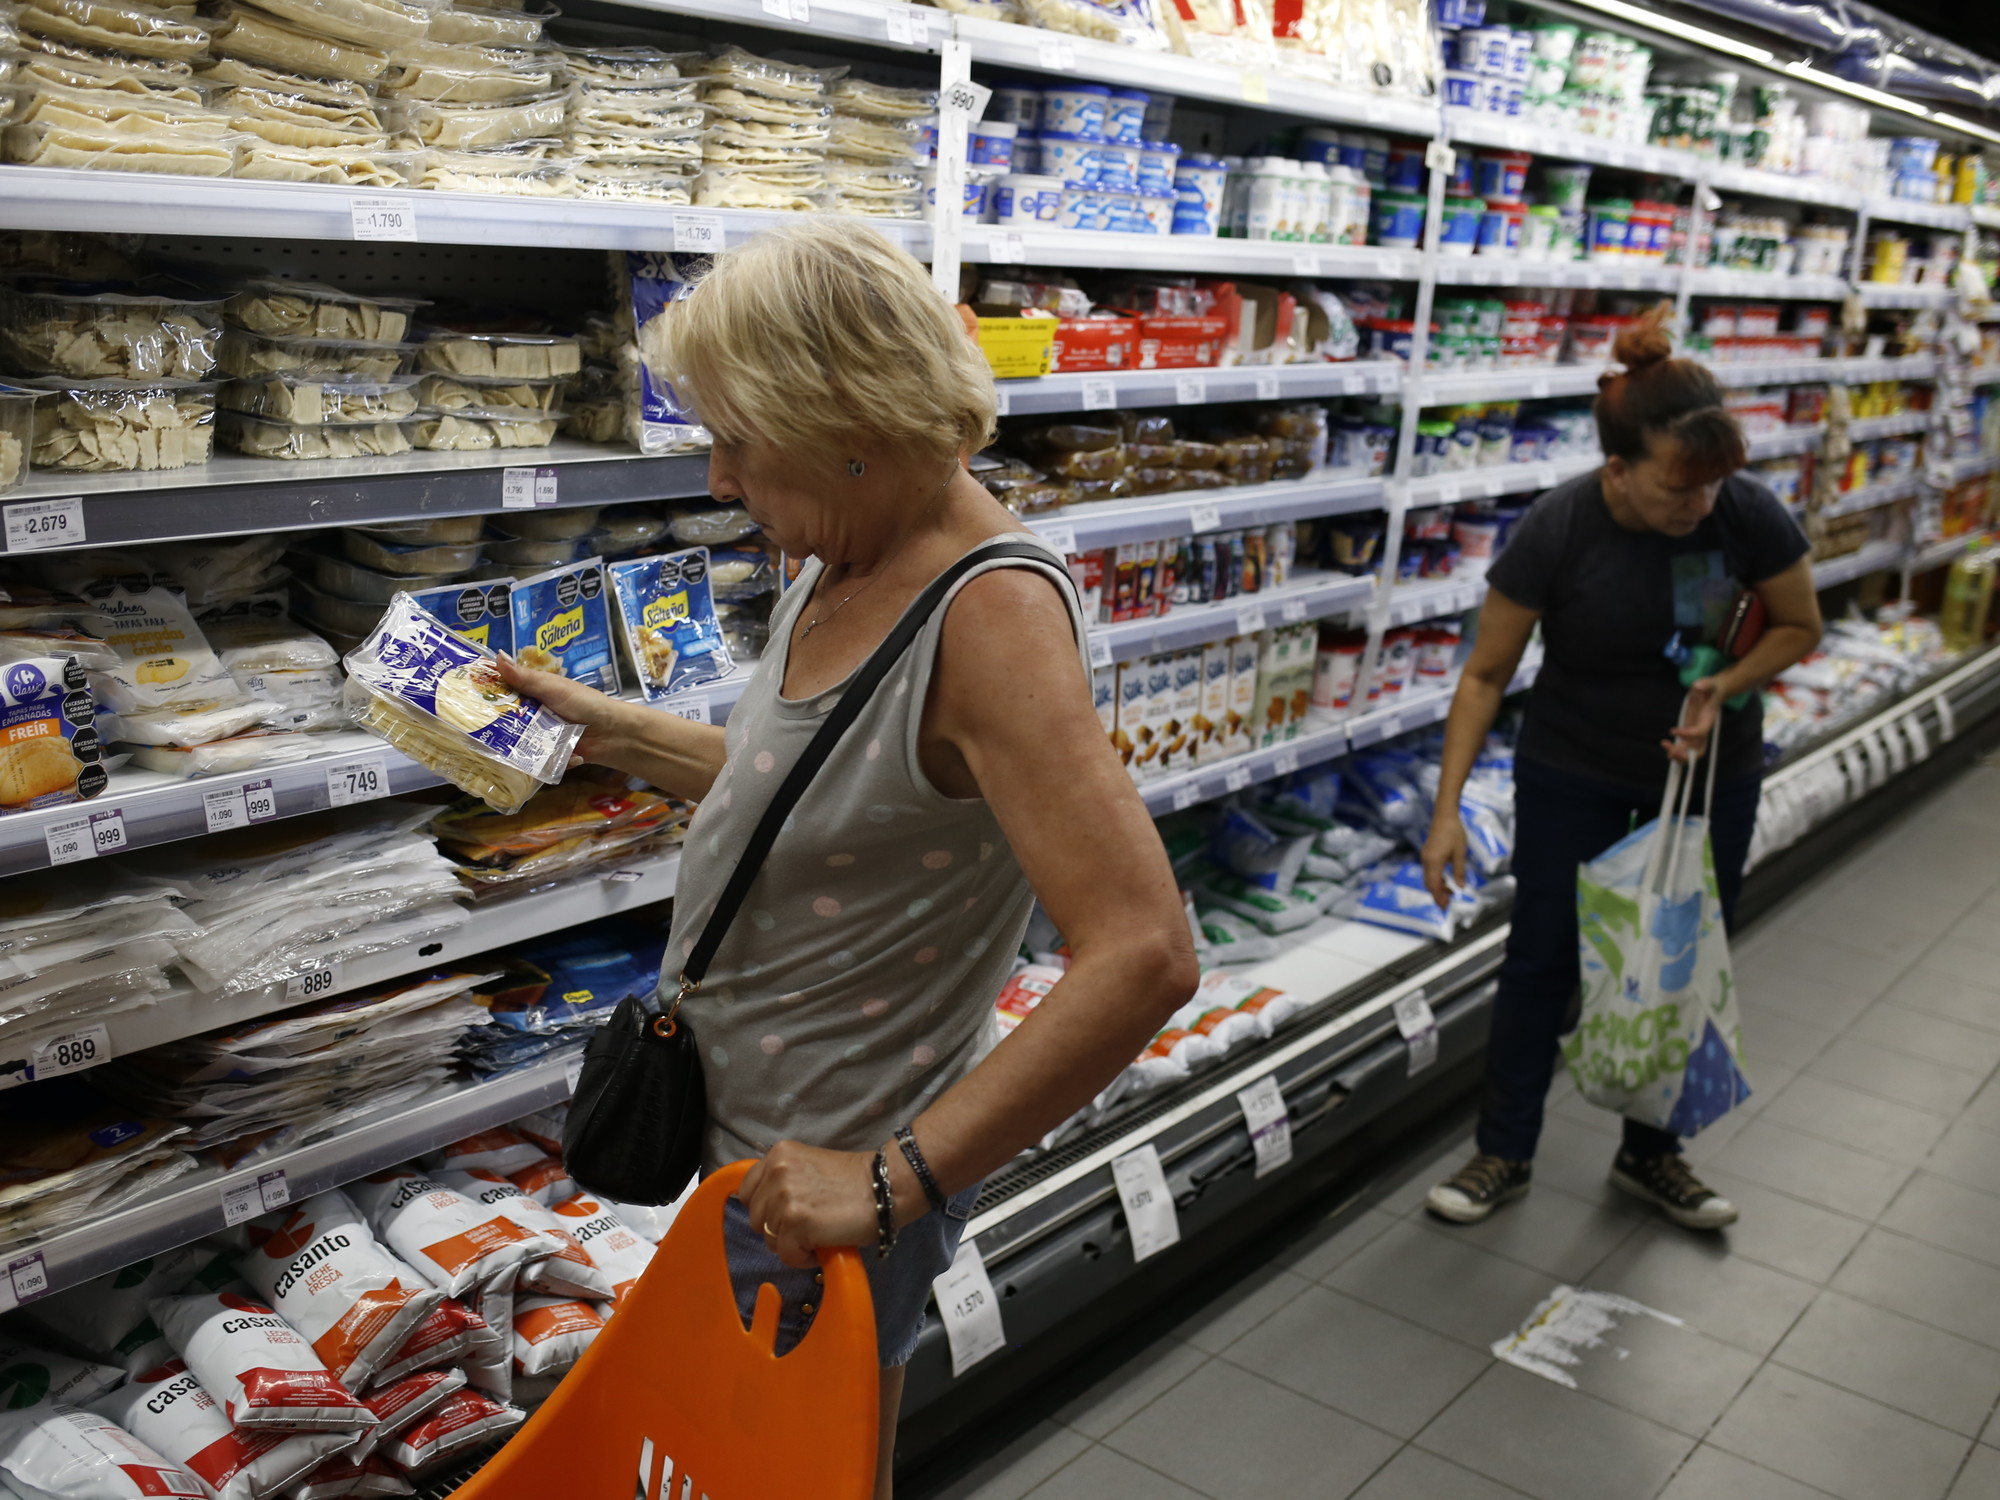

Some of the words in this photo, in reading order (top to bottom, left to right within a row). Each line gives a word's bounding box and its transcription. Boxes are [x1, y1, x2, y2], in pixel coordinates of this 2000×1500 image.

[951, 90, 975, 111] 990
[367, 213, 402, 228] $1.790
[24, 514, 67, 534] $2.679
[518, 600, 528, 619] 12
[647, 602, 684, 628] Salteña
[114, 619, 143, 630] TAPAS
[144, 617, 167, 627] PARA
[106, 627, 186, 647] empanadas
[539, 618, 581, 651] Salteña
[132, 643, 175, 656] criolla
[1206, 660, 1226, 686] Silk
[1233, 653, 1254, 678] Silk
[1147, 667, 1171, 699] Silk
[1174, 662, 1199, 692] Silk
[1122, 674, 1144, 707] Silk
[2, 709, 52, 727] EMPANADAS
[8, 707, 28, 717] TAPAS
[28, 703, 46, 712] PARA
[8, 721, 49, 742] FREÍR
[343, 771, 378, 794] $749
[211, 809, 232, 821] $1.090
[247, 799, 270, 814] $999
[96, 828, 120, 845] $999
[54, 842, 78, 855] $1.090
[300, 971, 332, 995] $889
[52, 1039, 95, 1066] $889
[110, 1128, 125, 1137] 2
[273, 1234, 351, 1299] casanto
[305, 1262, 334, 1287] LECHE
[18, 1275, 42, 1291] $1.090
[308, 1272, 344, 1296] FRESCA
